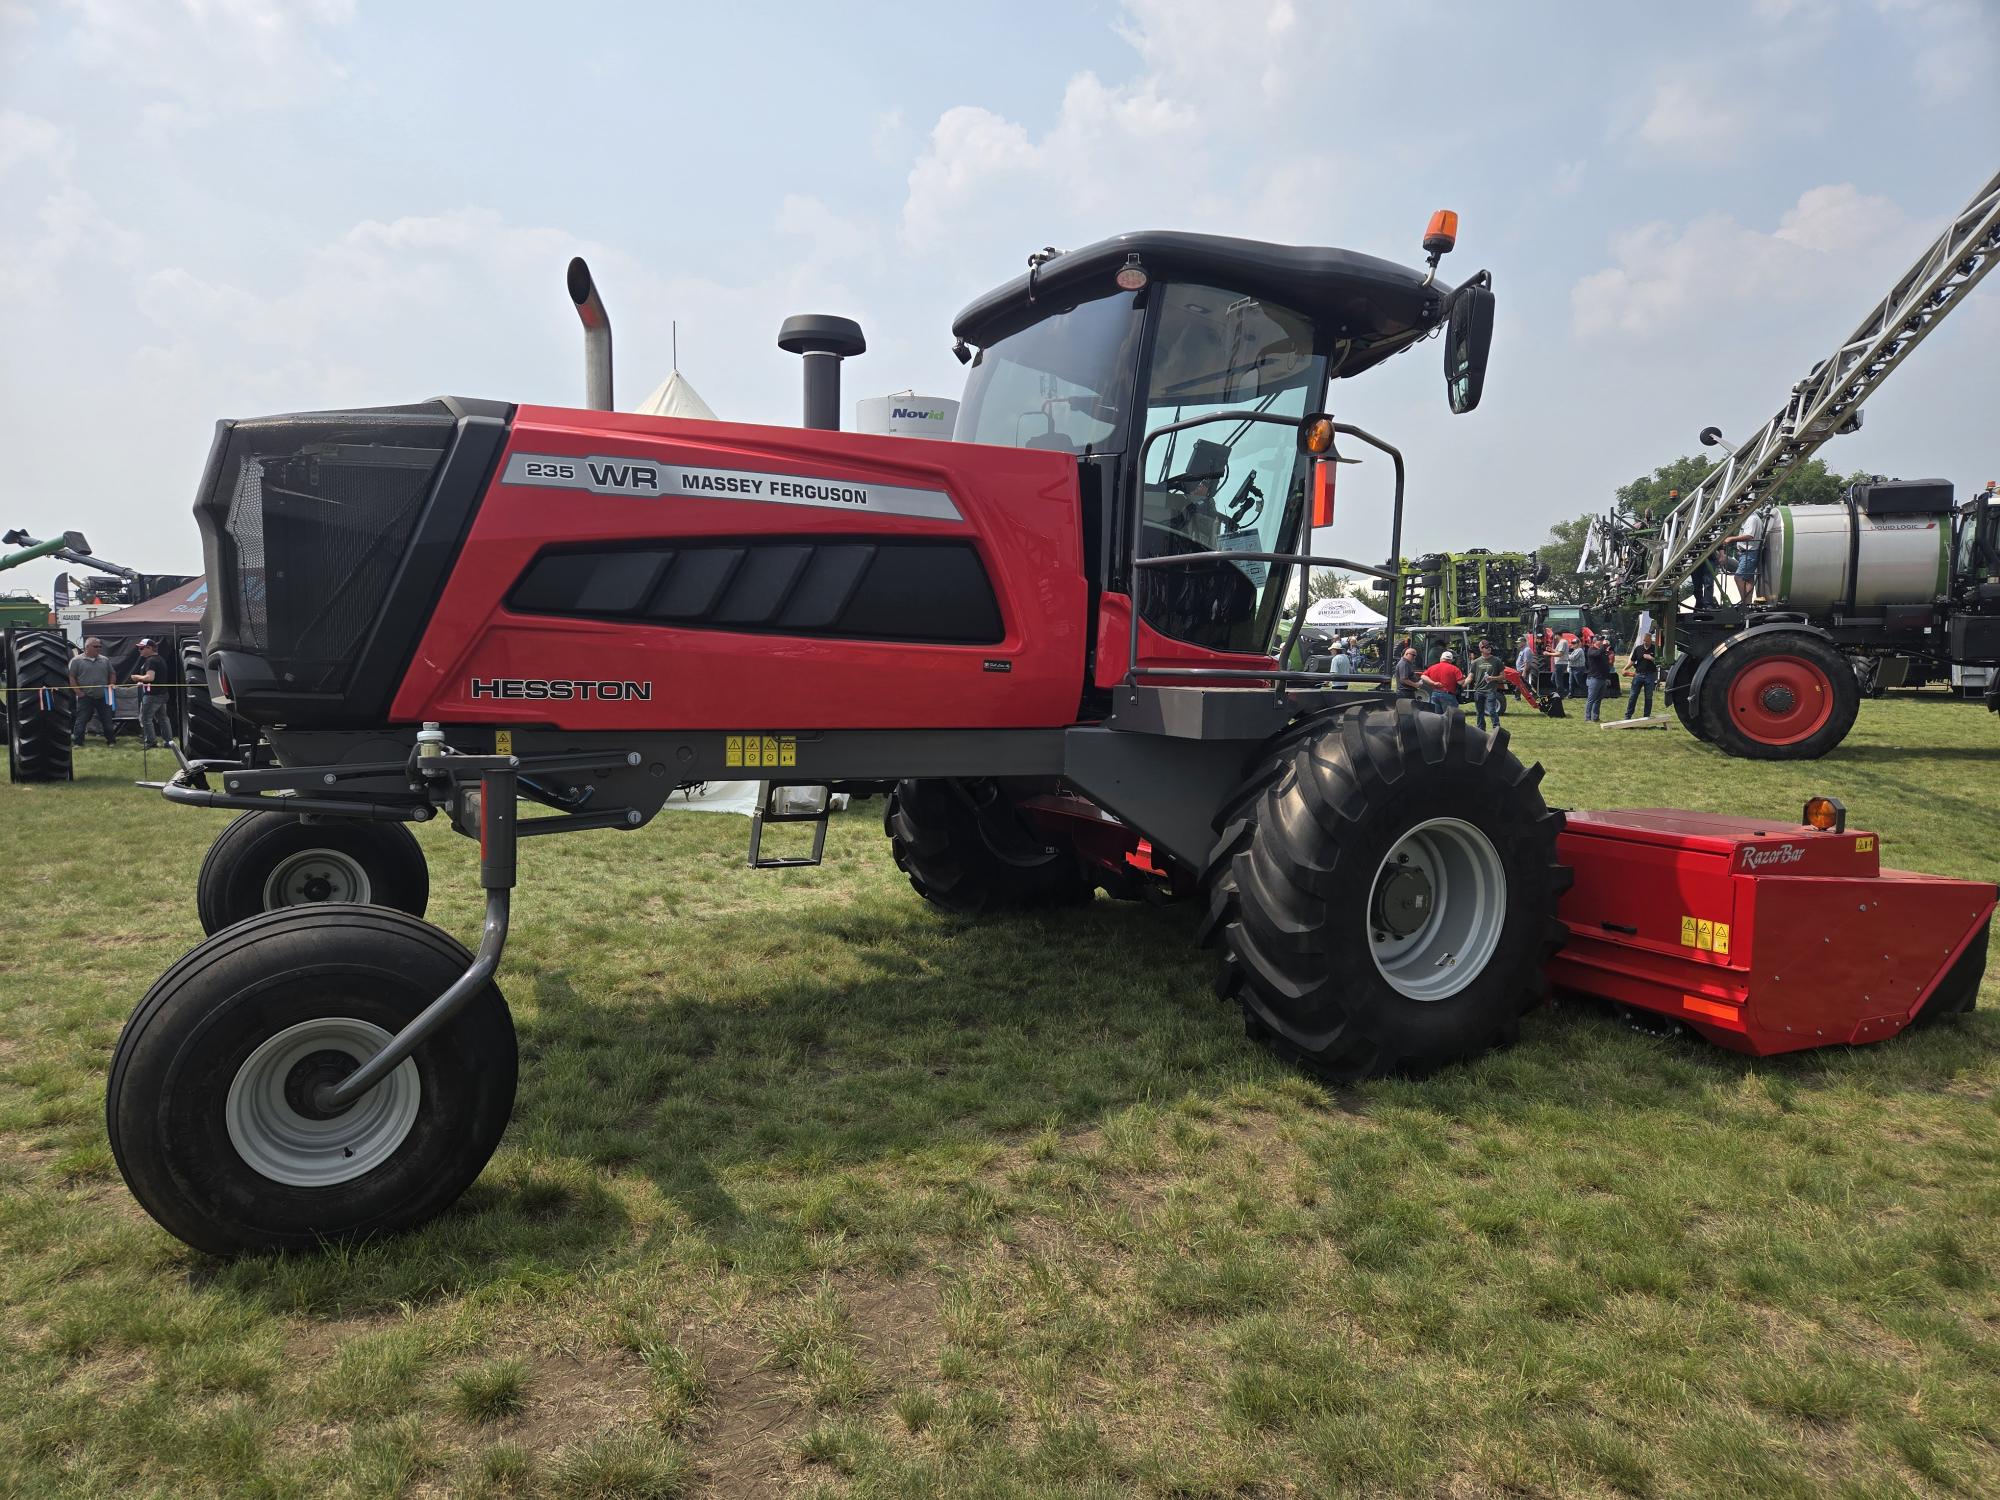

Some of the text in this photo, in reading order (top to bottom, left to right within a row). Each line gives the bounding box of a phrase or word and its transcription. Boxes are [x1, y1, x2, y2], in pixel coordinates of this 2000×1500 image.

[526, 461, 868, 504] 235 WR MASSEY FERGUSON
[471, 678, 652, 701] HESSTON
[1741, 844, 1806, 869] RazorBar
